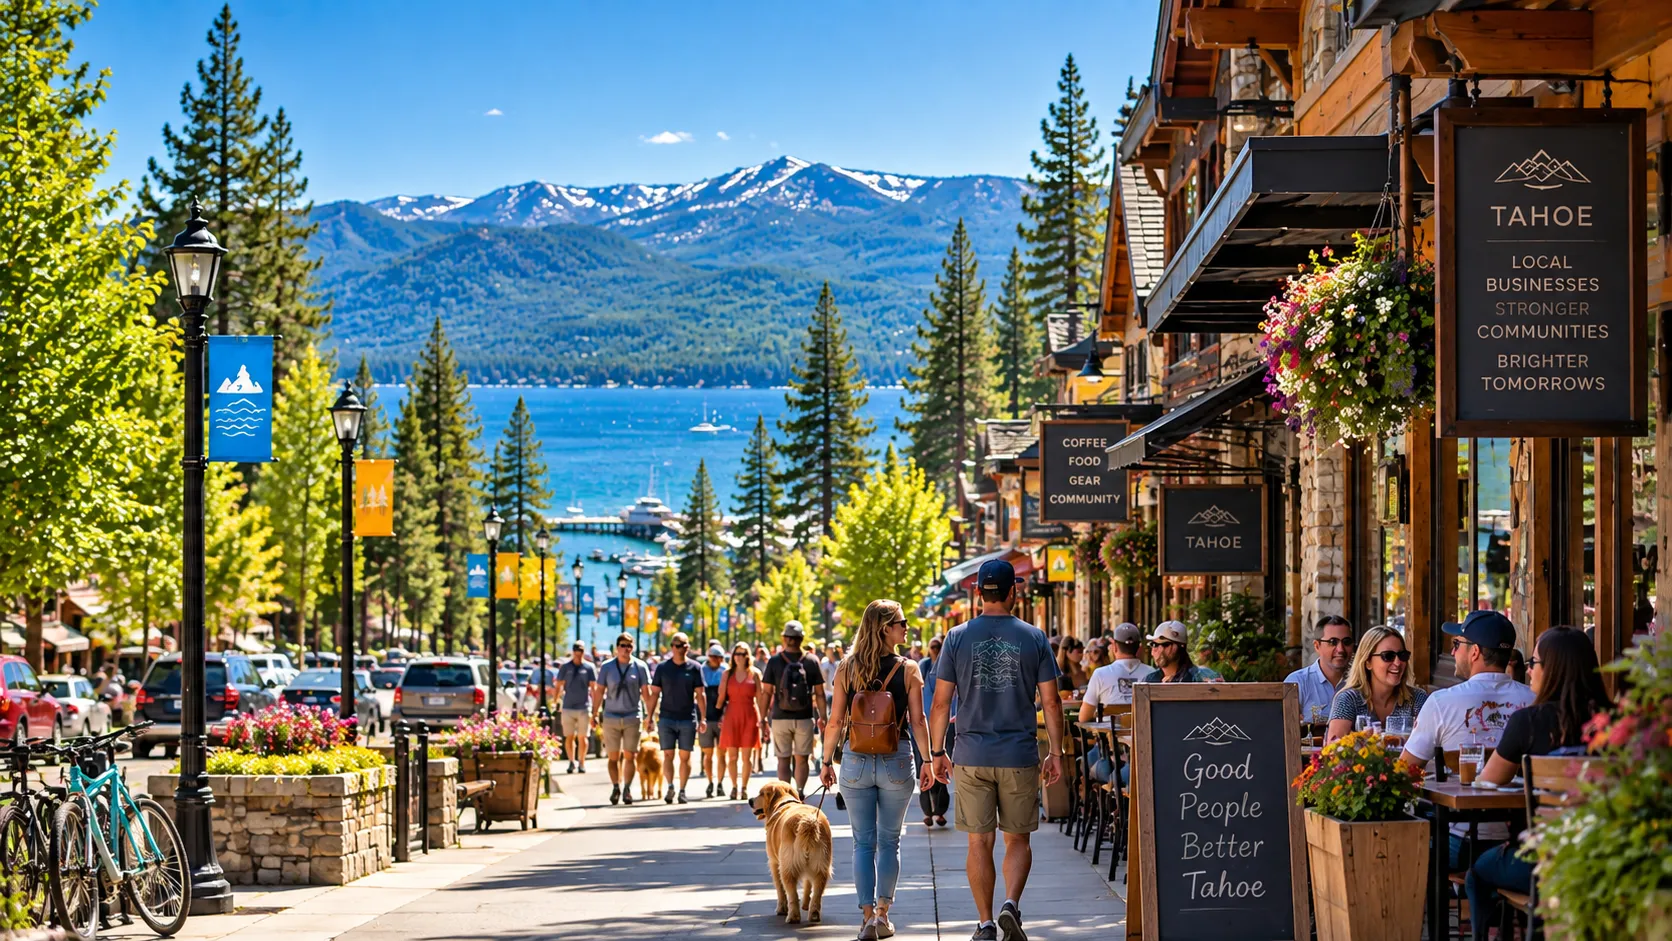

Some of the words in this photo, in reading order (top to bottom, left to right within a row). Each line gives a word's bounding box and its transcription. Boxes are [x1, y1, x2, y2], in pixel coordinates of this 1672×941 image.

[1491, 205, 1593, 227] TAHOE
[1512, 255, 1573, 270] LOCAL
[1486, 277, 1600, 292] BUSINESSES
[1495, 301, 1590, 316] STRONGER
[1477, 324, 1609, 339] COMMUNITIES
[1497, 353, 1589, 369] BRIGHTER
[1481, 376, 1606, 391] TOMORROWS
[1062, 438, 1108, 448] COFFEE
[1068, 456, 1101, 466] FOOD
[1069, 475, 1101, 486] GEAR
[1049, 494, 1121, 504] COMMUNITY
[1185, 535, 1242, 549] TAHOE
[1183, 752, 1254, 789] Good
[1180, 791, 1262, 827] People
[1180, 831, 1265, 860] Better
[1182, 869, 1266, 900] Tahoe
